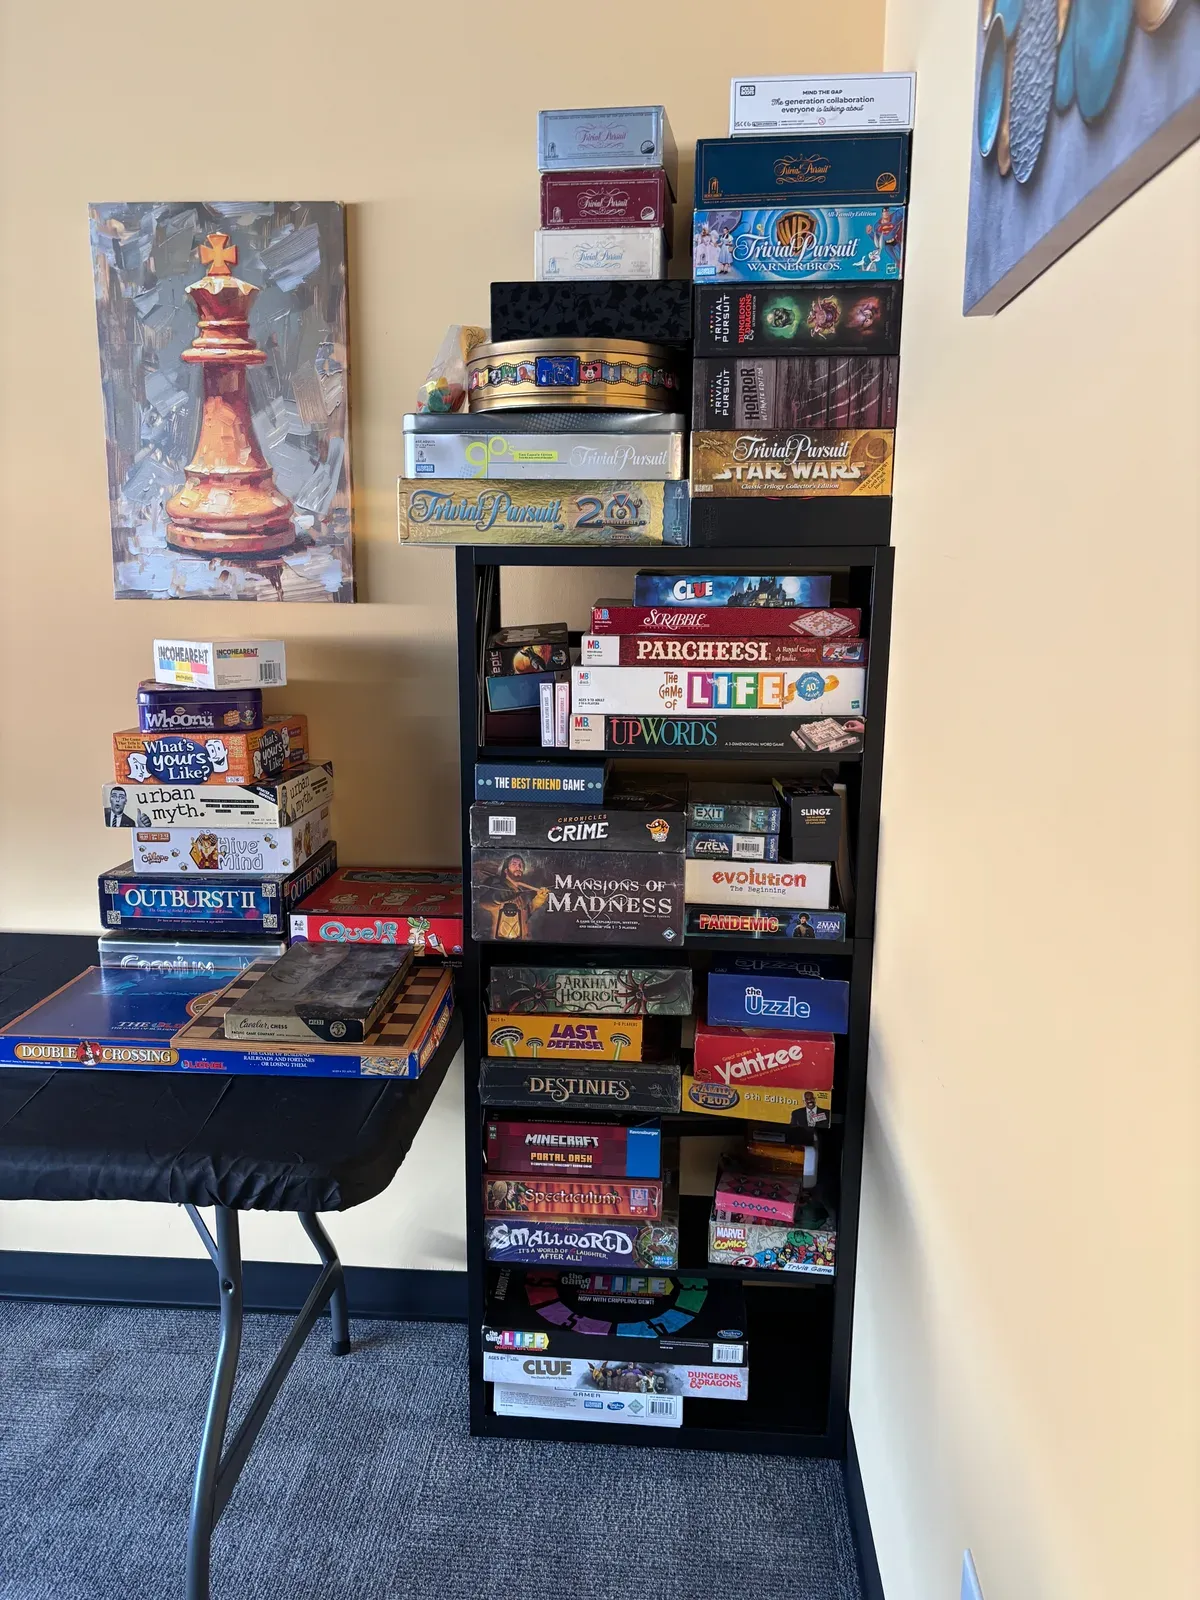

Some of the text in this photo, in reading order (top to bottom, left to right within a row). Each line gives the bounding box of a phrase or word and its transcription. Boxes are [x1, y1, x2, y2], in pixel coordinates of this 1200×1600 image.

[784, 98, 824, 106] generation
[826, 96, 874, 104] collaboration
[823, 106, 844, 114] talking
[775, 163, 830, 176] Trivial Pursuit
[579, 196, 628, 208] Trivial Pursuit
[733, 231, 860, 265] Trivial Pursuit
[747, 262, 842, 272] WARNER BROS.
[733, 434, 848, 465] Trivial Pursuit
[569, 445, 668, 471] Trivial Pursuit
[712, 462, 866, 480] STAR WARS
[408, 488, 562, 531] Trivial Pursuit
[673, 580, 714, 600] CLUE
[643, 609, 707, 630] SCRABBLE
[158, 646, 208, 664] INCOHEARENT
[636, 640, 769, 661] PARCHEESI
[782, 645, 798, 654] Royal
[490, 651, 502, 673] epic
[689, 673, 783, 707] LIFE
[146, 710, 214, 728] Whoonu
[258, 731, 278, 747] What's
[610, 717, 717, 746] UPWORDS
[144, 739, 194, 753] What's
[262, 742, 282, 765] yours
[153, 752, 206, 771] yours
[269, 753, 284, 771] Like?
[168, 766, 210, 780] Like?
[290, 776, 310, 799] urban
[495, 777, 585, 791] THE BEST FRIEND GAME
[136, 788, 196, 804] urban
[152, 806, 206, 824] myth.
[558, 814, 607, 822] CHRONICLES
[696, 808, 722, 819] EXIT
[548, 822, 609, 842] CRIME
[218, 836, 258, 854] Hive
[696, 841, 728, 850] CREW
[218, 854, 264, 871] Mind
[554, 874, 666, 894] MANSIONS OF
[712, 868, 806, 888] evolution
[125, 889, 255, 908] OUTBURST II
[748, 886, 786, 895] Beginning
[547, 892, 672, 916] MADNESS
[700, 914, 778, 932] PANDEMIC
[319, 920, 398, 944] Quelf
[564, 976, 618, 990] ARKHAM
[561, 989, 621, 1004] HORROR
[746, 987, 762, 996] the
[746, 996, 810, 1018] Uzzle
[240, 1018, 268, 1030] Cavalier
[550, 1024, 598, 1040] LAST
[546, 1040, 604, 1051] DEFENSE!
[22, 1046, 171, 1062] DOUBLE CROSSING
[714, 1045, 803, 1085] Yahtzee
[530, 1078, 630, 1102] DESTINIES
[692, 1083, 737, 1098] FAMILY
[698, 1093, 730, 1106] FEUD
[744, 1092, 798, 1105] 6th Edition
[525, 1134, 599, 1148] MINECRAFT
[530, 1152, 592, 1163] PORTAL DASH
[524, 1188, 622, 1205] Spectaculum
[716, 1227, 744, 1240] MARVEL
[714, 1240, 747, 1250] COMICS
[787, 1264, 808, 1272] Trivia
[562, 1276, 591, 1286] Game
[594, 1276, 666, 1294] LIFE
[504, 1332, 546, 1349] LIFE
[522, 1360, 572, 1376] CLUE
[688, 1371, 738, 1380] DUNGEONS
[690, 1378, 742, 1388] & DRAGONS
